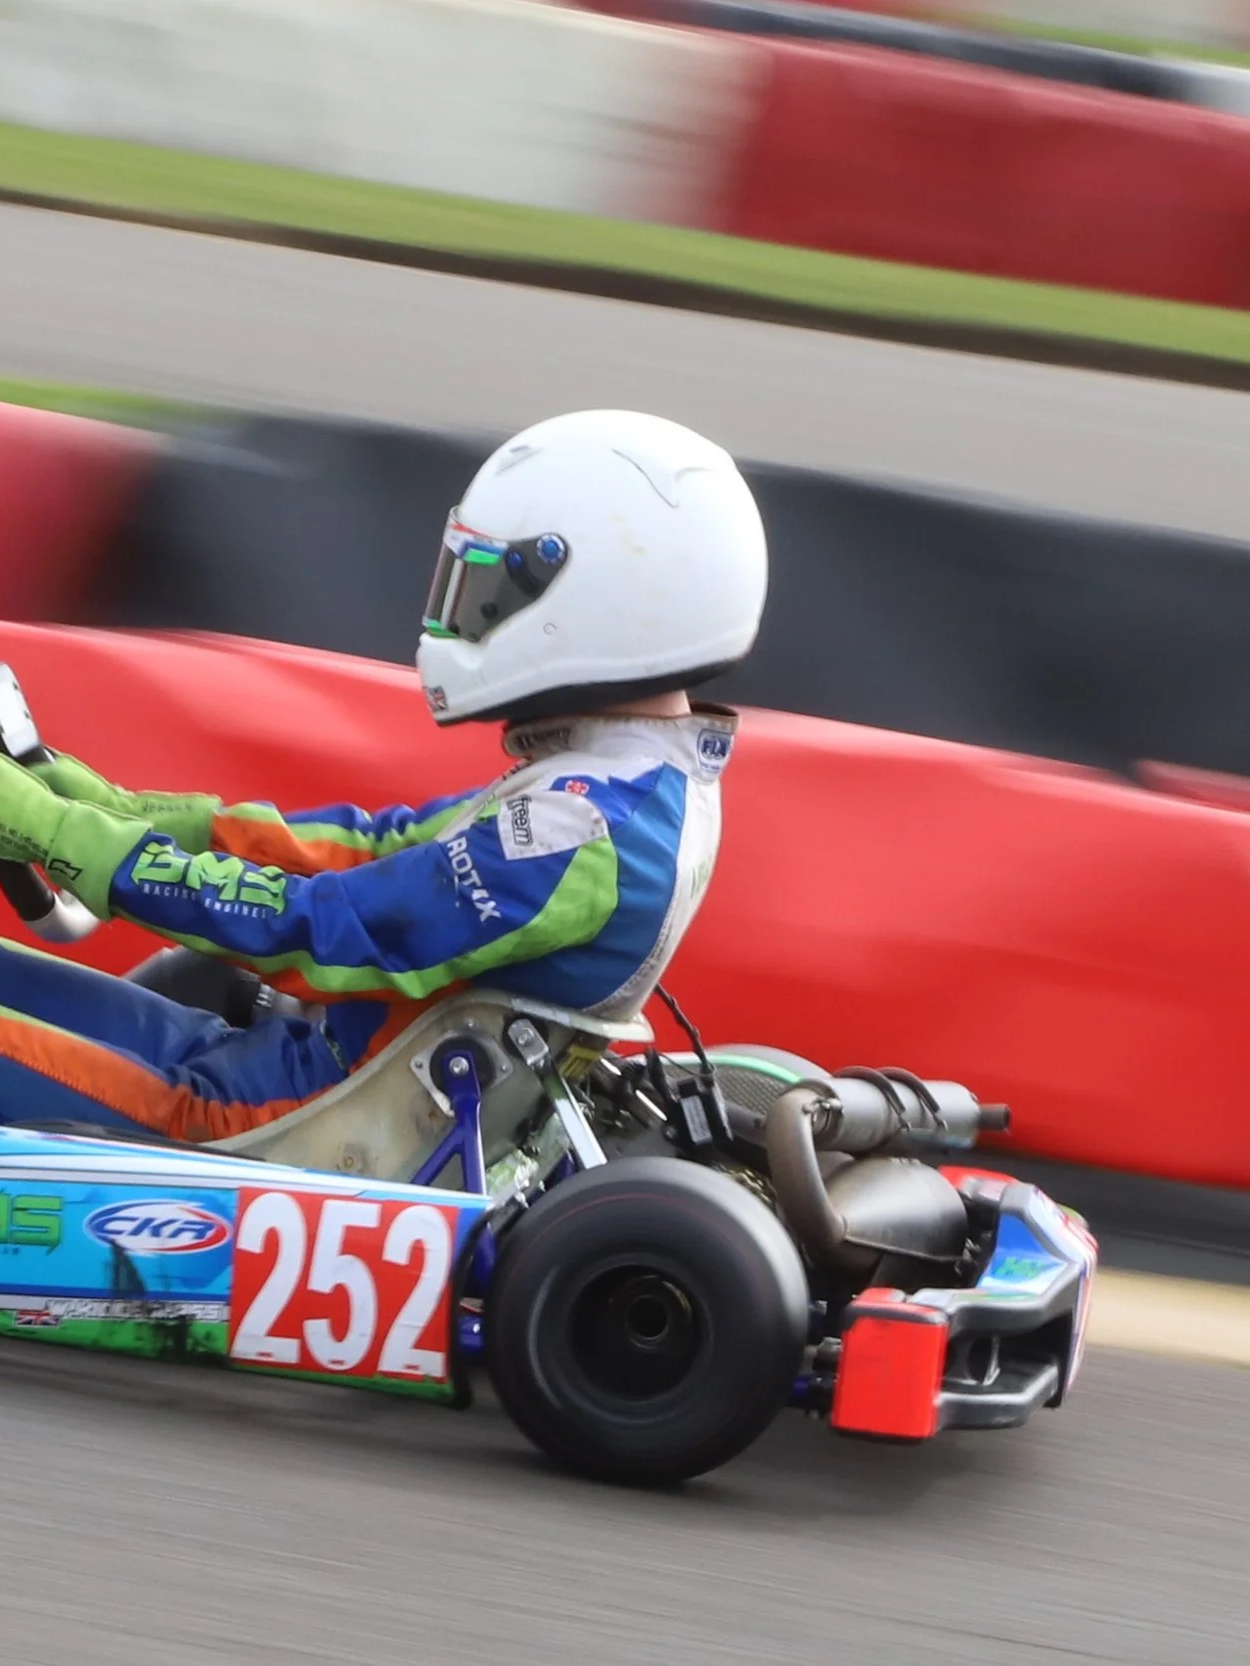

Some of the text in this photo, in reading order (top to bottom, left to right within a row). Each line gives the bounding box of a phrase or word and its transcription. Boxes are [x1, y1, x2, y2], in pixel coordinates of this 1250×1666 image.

[130, 841, 287, 916] GMS
[98, 1215, 217, 1240] CKR
[230, 1191, 451, 1379] 252
